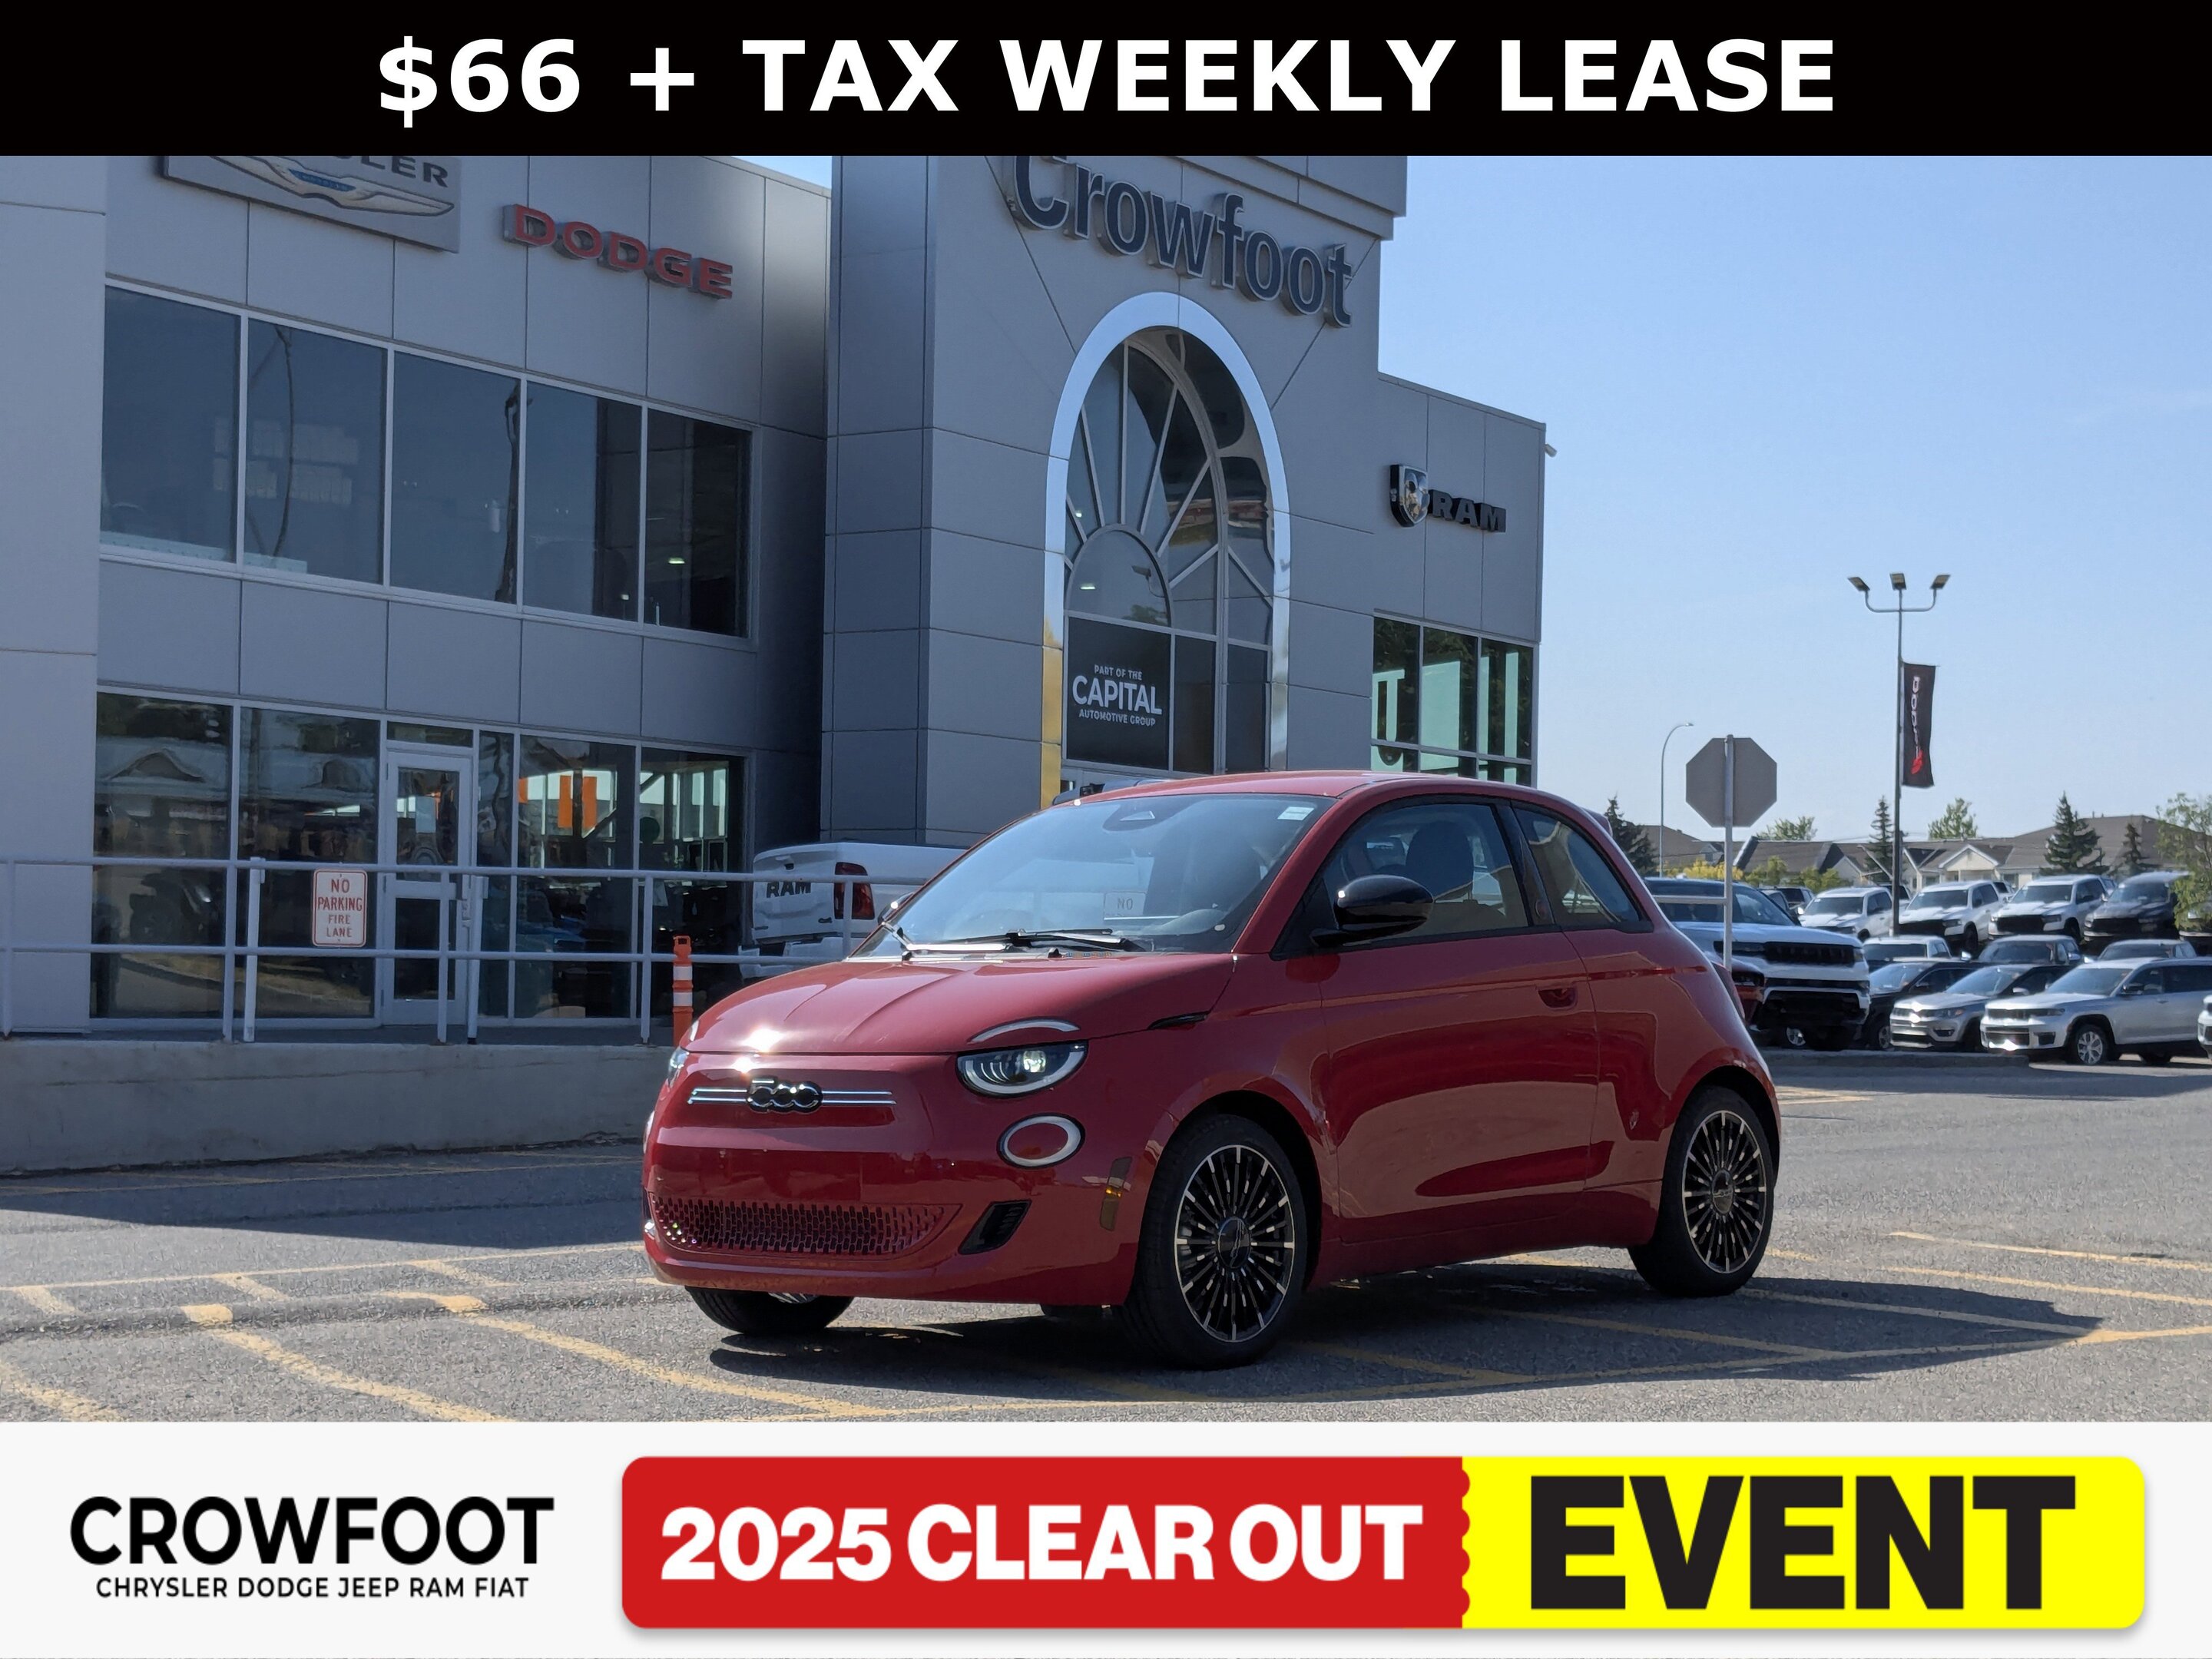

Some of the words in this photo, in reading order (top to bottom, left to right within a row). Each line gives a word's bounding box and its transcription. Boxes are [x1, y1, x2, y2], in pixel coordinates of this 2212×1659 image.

[504, 204, 733, 300] DODGE
[1429, 489, 1506, 532] RAM
[1094, 664, 1114, 677] PART
[1115, 667, 1127, 678] OF
[1128, 670, 1143, 681] THE
[1072, 674, 1163, 715] CAPITAL
[1078, 708, 1128, 724] AUTOMOTIVE
[1129, 714, 1156, 727] GROUP
[330, 878, 350, 893] NO
[766, 881, 812, 899] RAM
[317, 896, 363, 912] PARKING
[328, 914, 351, 925] FIRE
[326, 927, 353, 938] LANE
